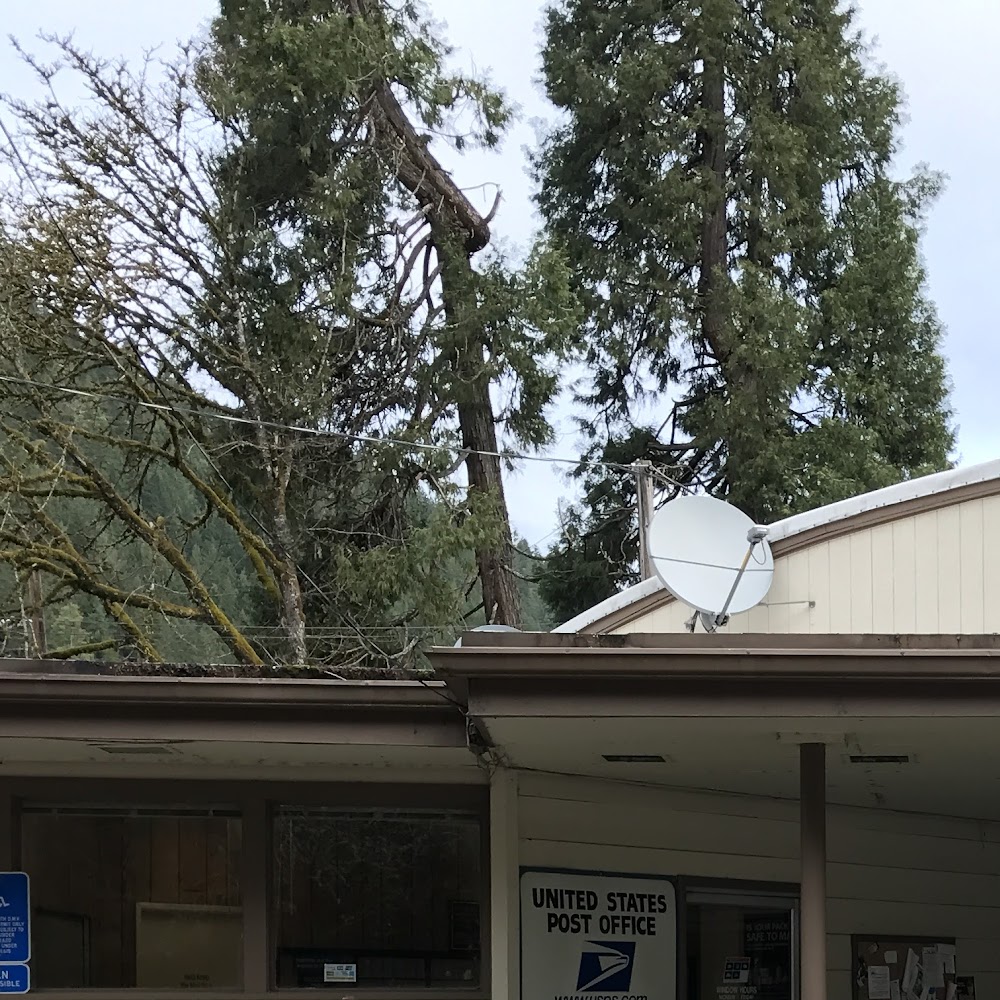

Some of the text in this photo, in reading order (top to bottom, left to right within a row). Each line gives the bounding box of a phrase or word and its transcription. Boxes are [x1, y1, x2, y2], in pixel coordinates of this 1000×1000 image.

[531, 887, 668, 914] UNITED STATES
[547, 912, 657, 936] POST OFFICE
[746, 932, 767, 942] SAFE
[768, 932, 779, 941] TO
